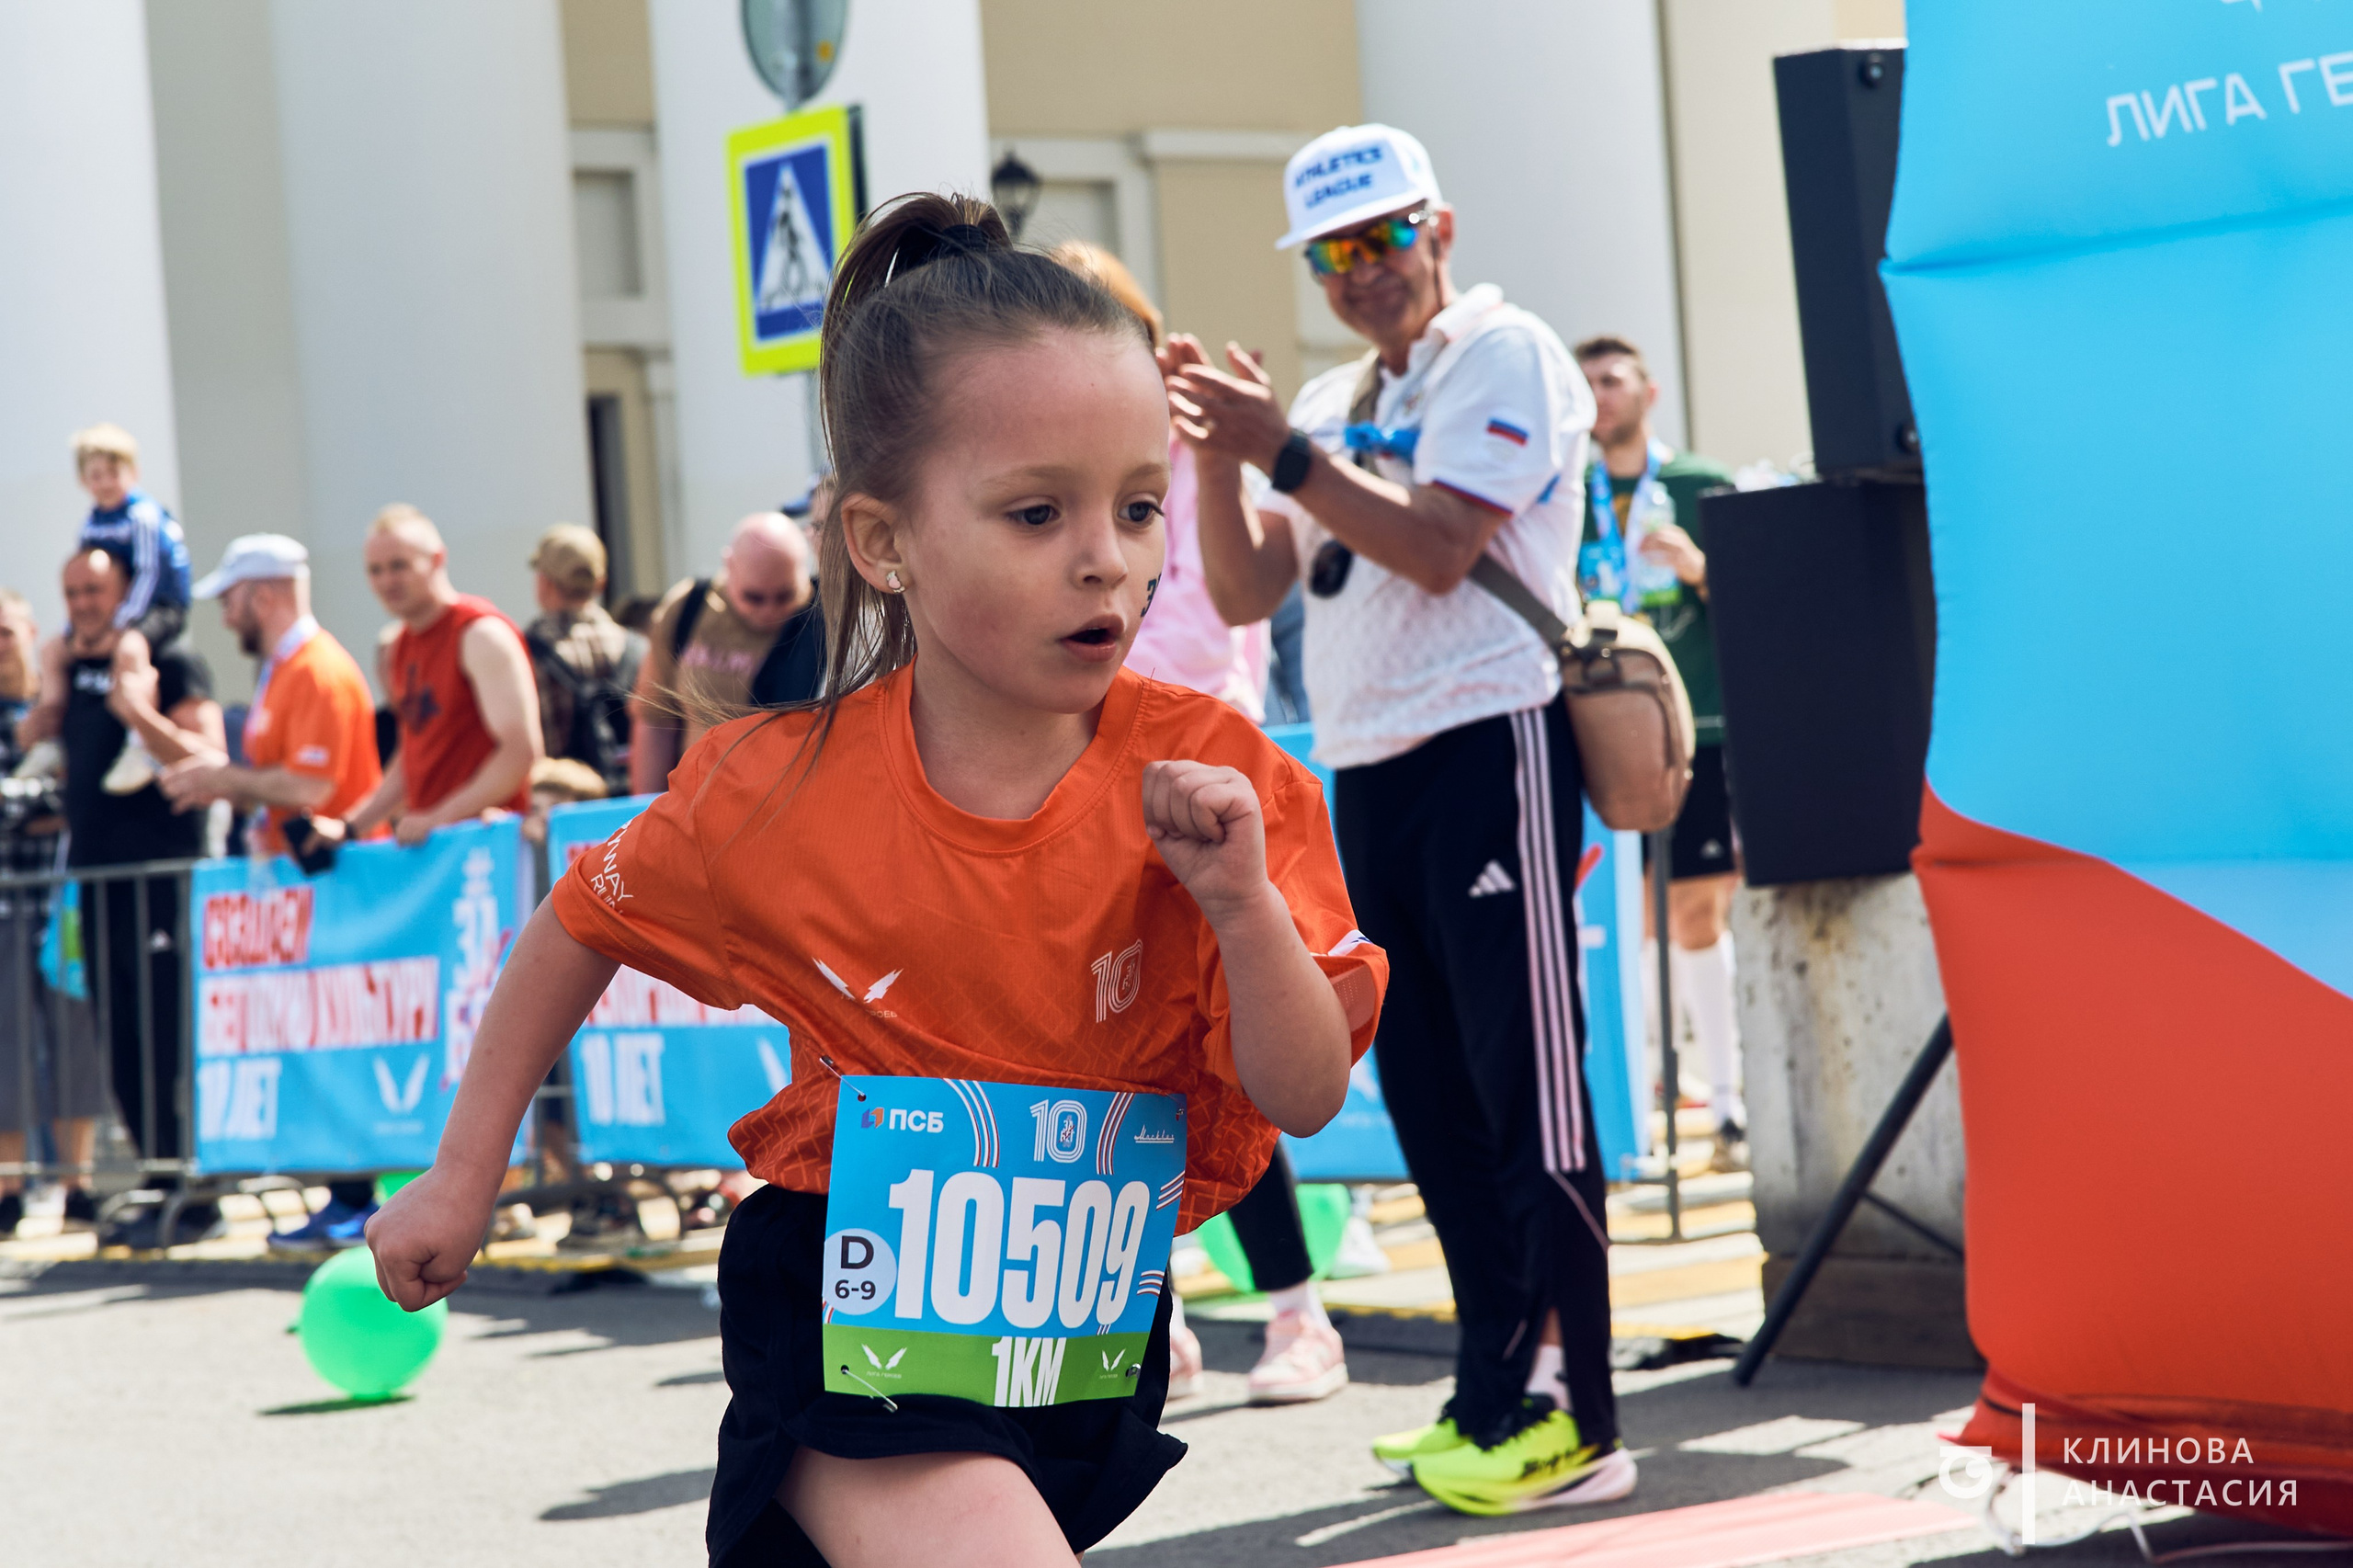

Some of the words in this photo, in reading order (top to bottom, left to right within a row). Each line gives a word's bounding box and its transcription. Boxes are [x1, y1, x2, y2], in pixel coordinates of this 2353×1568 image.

[2106, 72, 2268, 147] ЛИГА
[889, 1108, 945, 1133] ПСБ
[840, 1234, 874, 1270] D
[888, 1168, 1151, 1330] 10509
[835, 1278, 877, 1301] 6-9
